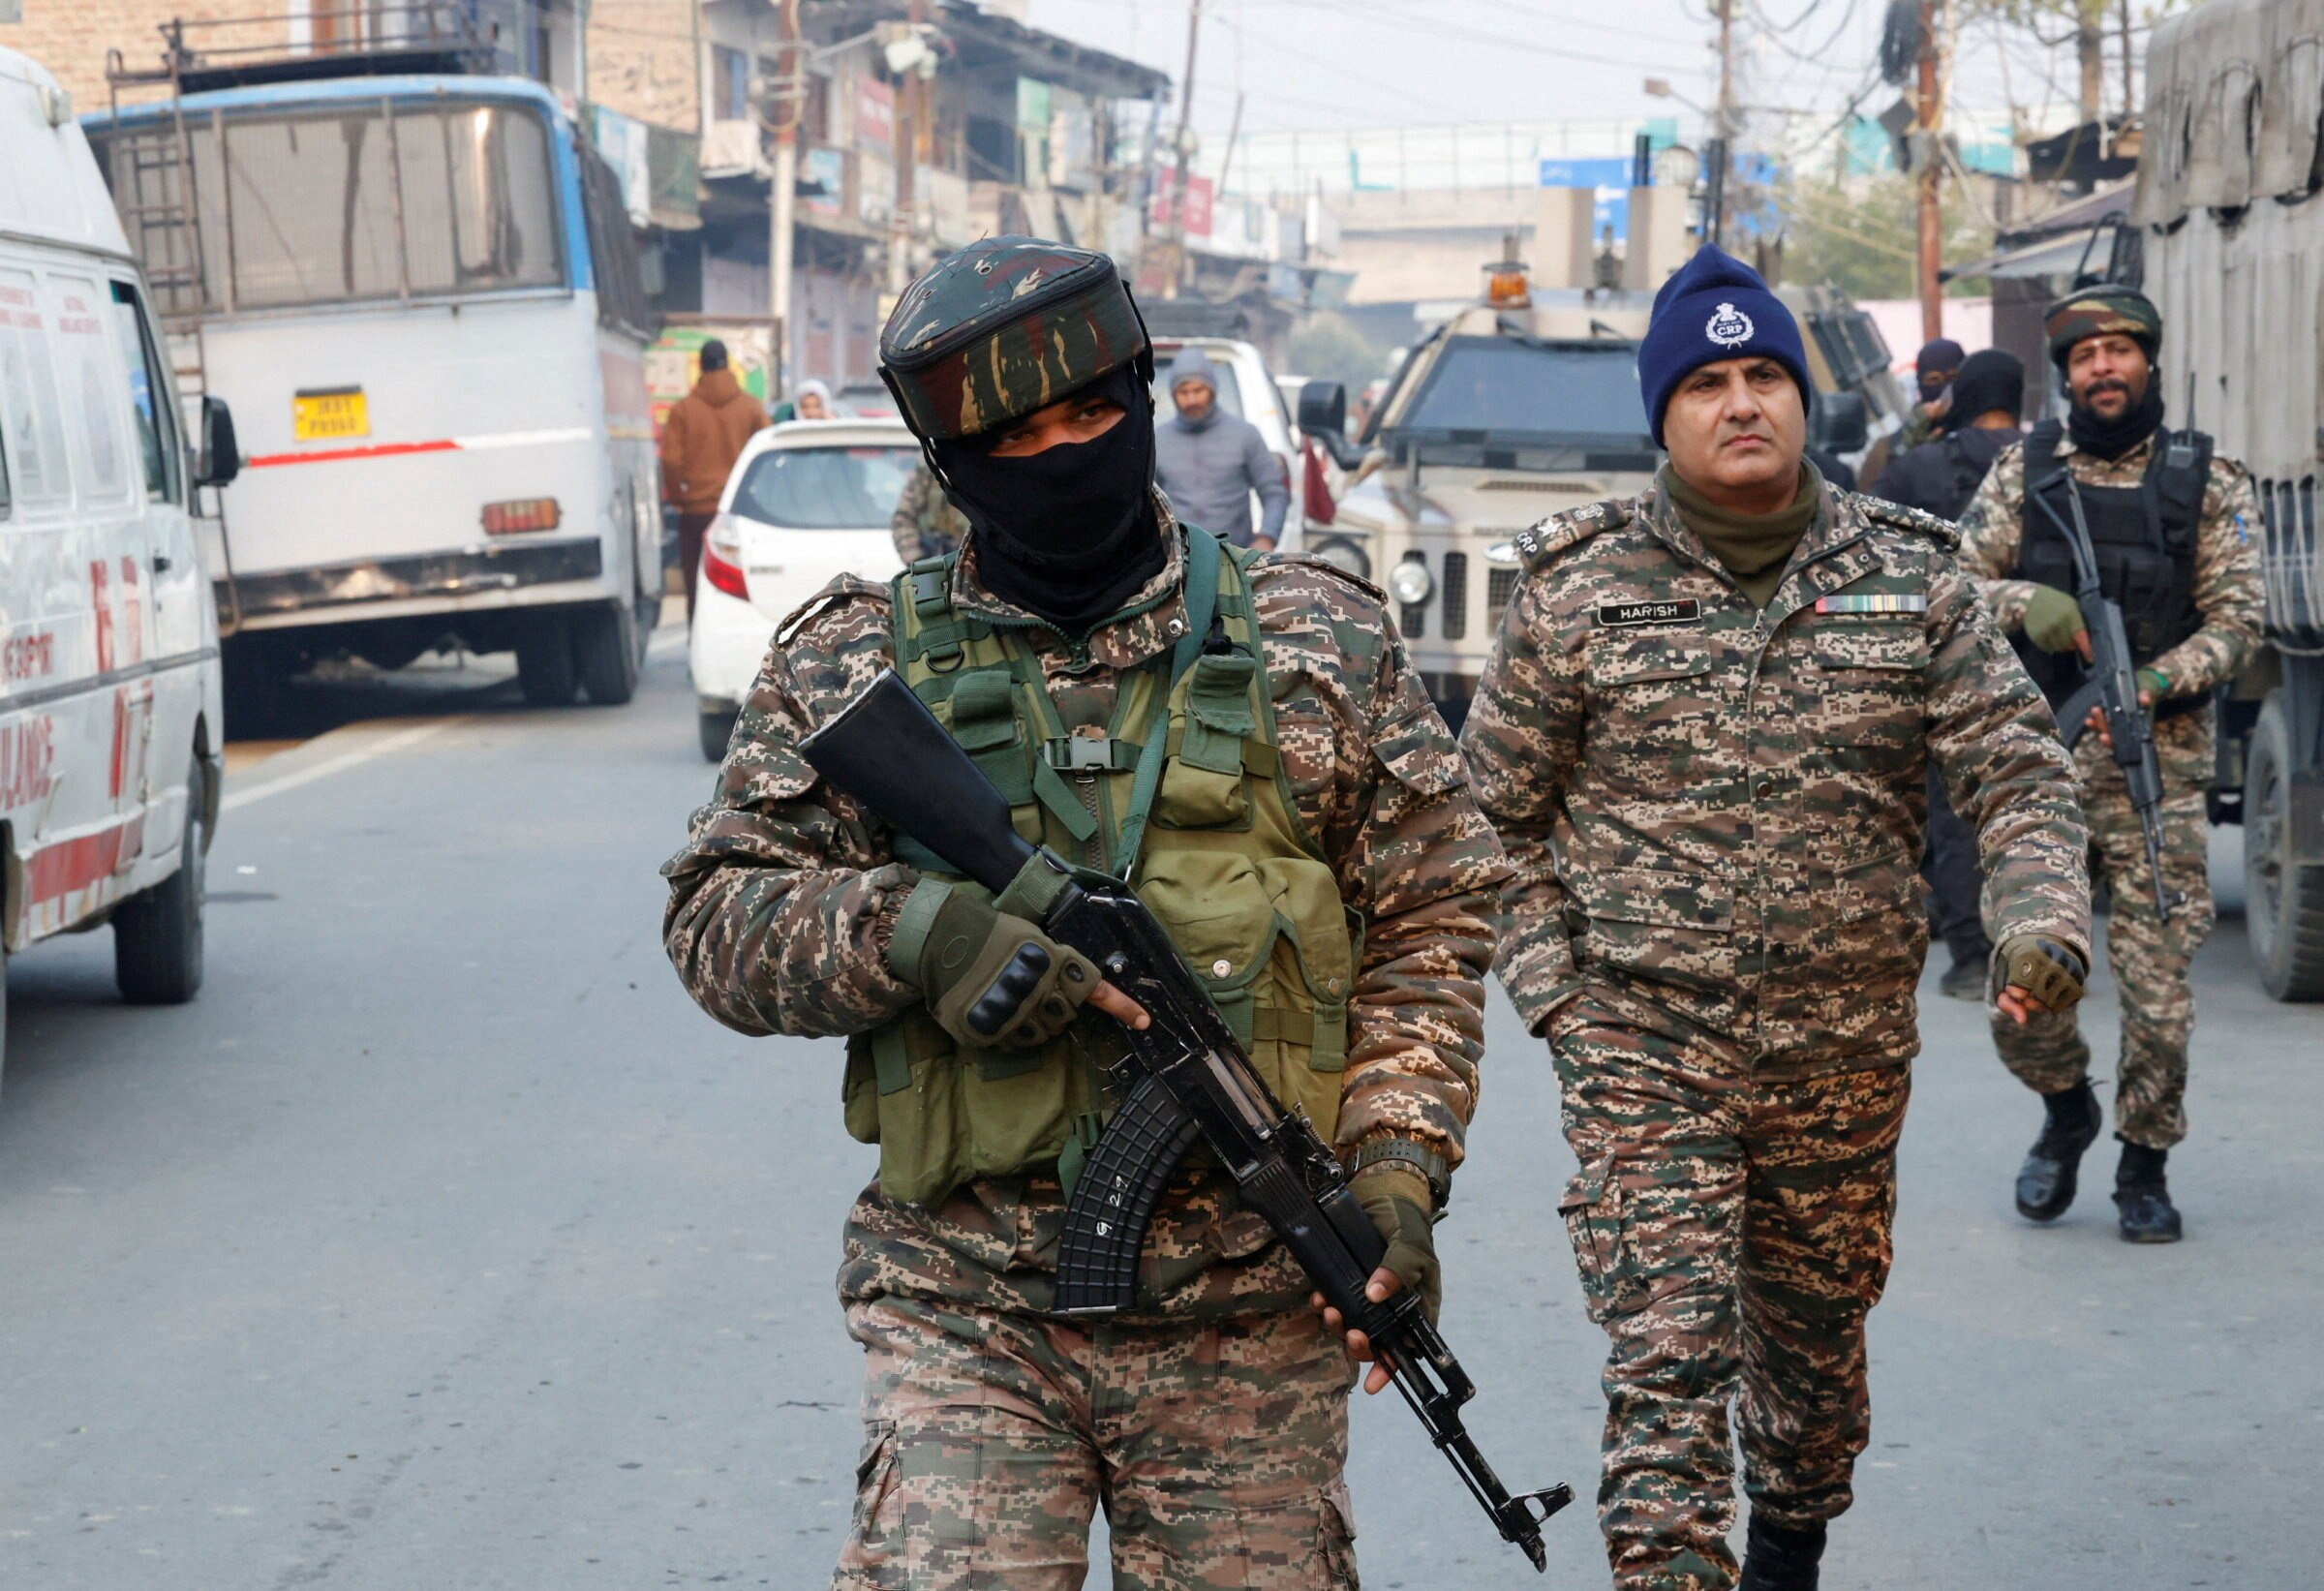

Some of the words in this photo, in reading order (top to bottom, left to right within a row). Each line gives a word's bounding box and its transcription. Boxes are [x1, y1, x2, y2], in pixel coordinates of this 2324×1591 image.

[1717, 324, 1743, 336] CRP
[1516, 532, 1538, 553] CRP
[1620, 605, 1677, 619] HARISH
